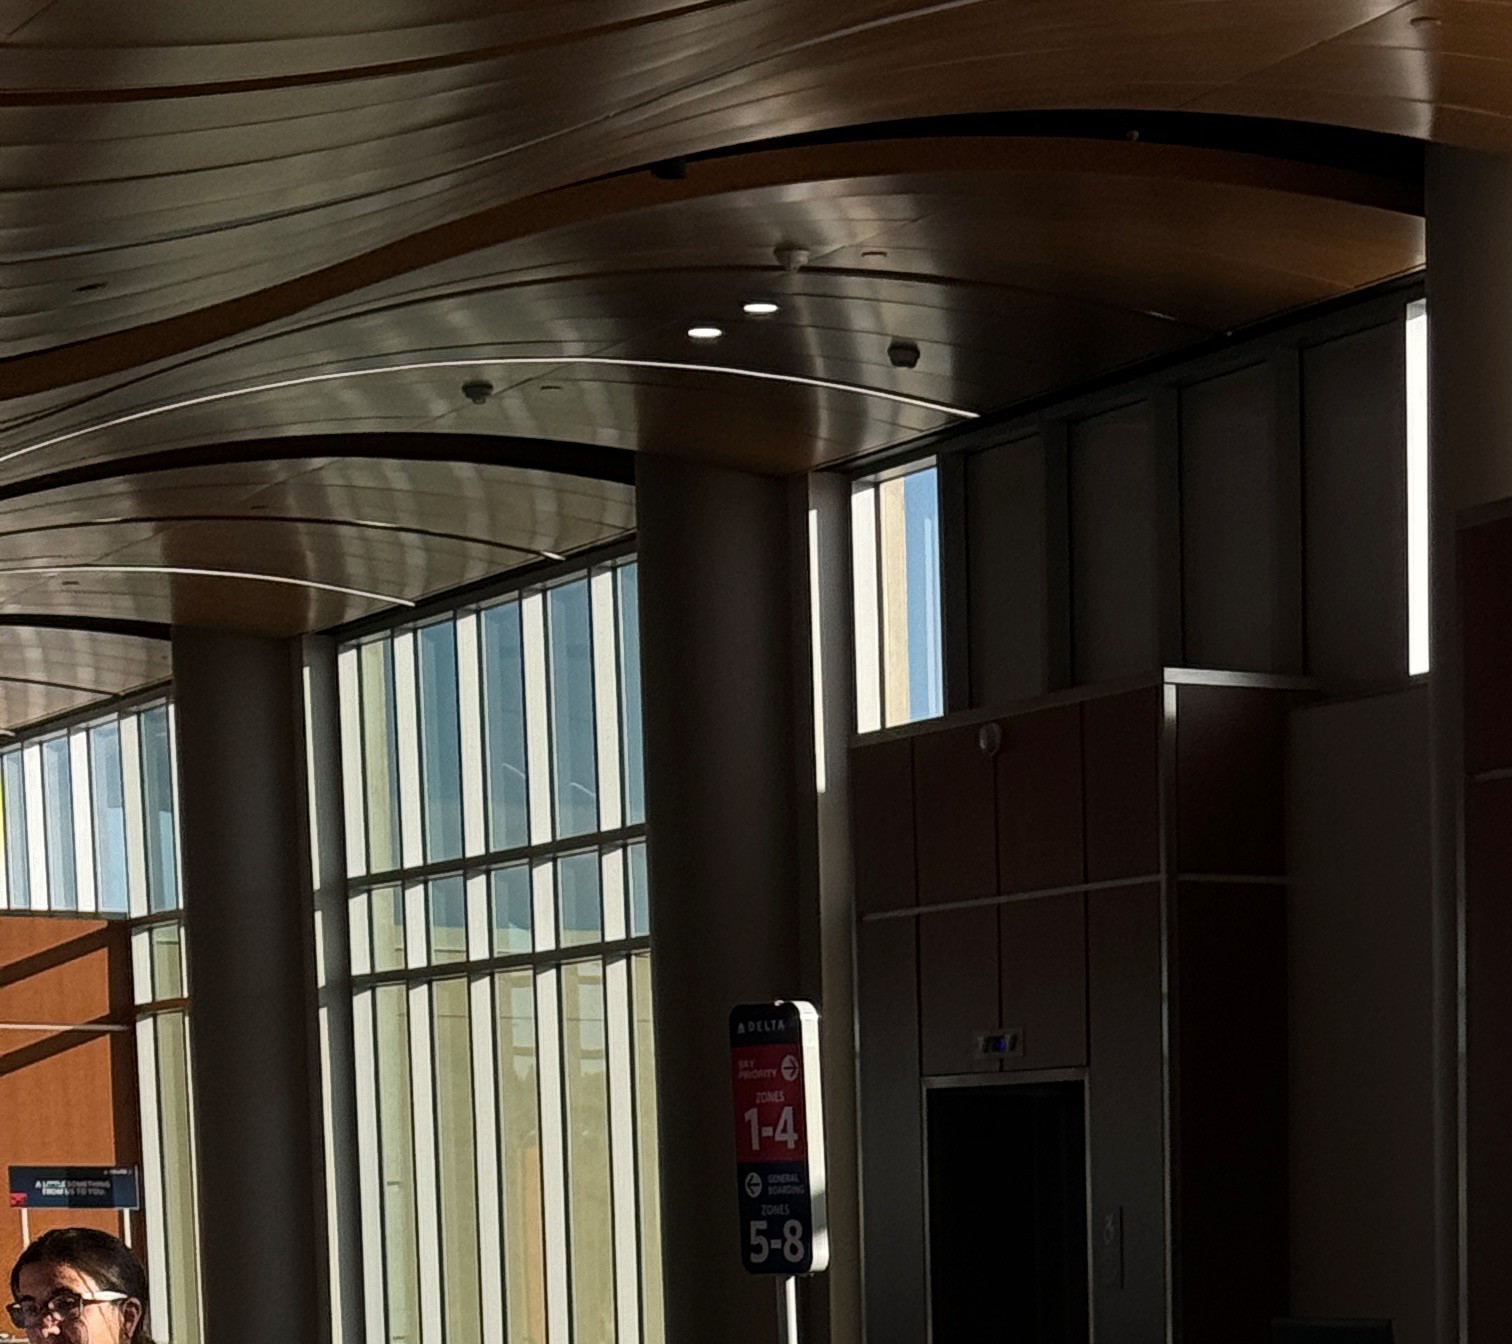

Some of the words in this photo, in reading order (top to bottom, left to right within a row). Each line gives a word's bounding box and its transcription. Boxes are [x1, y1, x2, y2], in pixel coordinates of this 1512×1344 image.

[747, 1019, 785, 1033] DELTA
[755, 1090, 785, 1104] ZONES
[743, 1105, 799, 1152] 1-4
[760, 1203, 791, 1216] ZONES
[750, 1218, 805, 1264] 5-8
